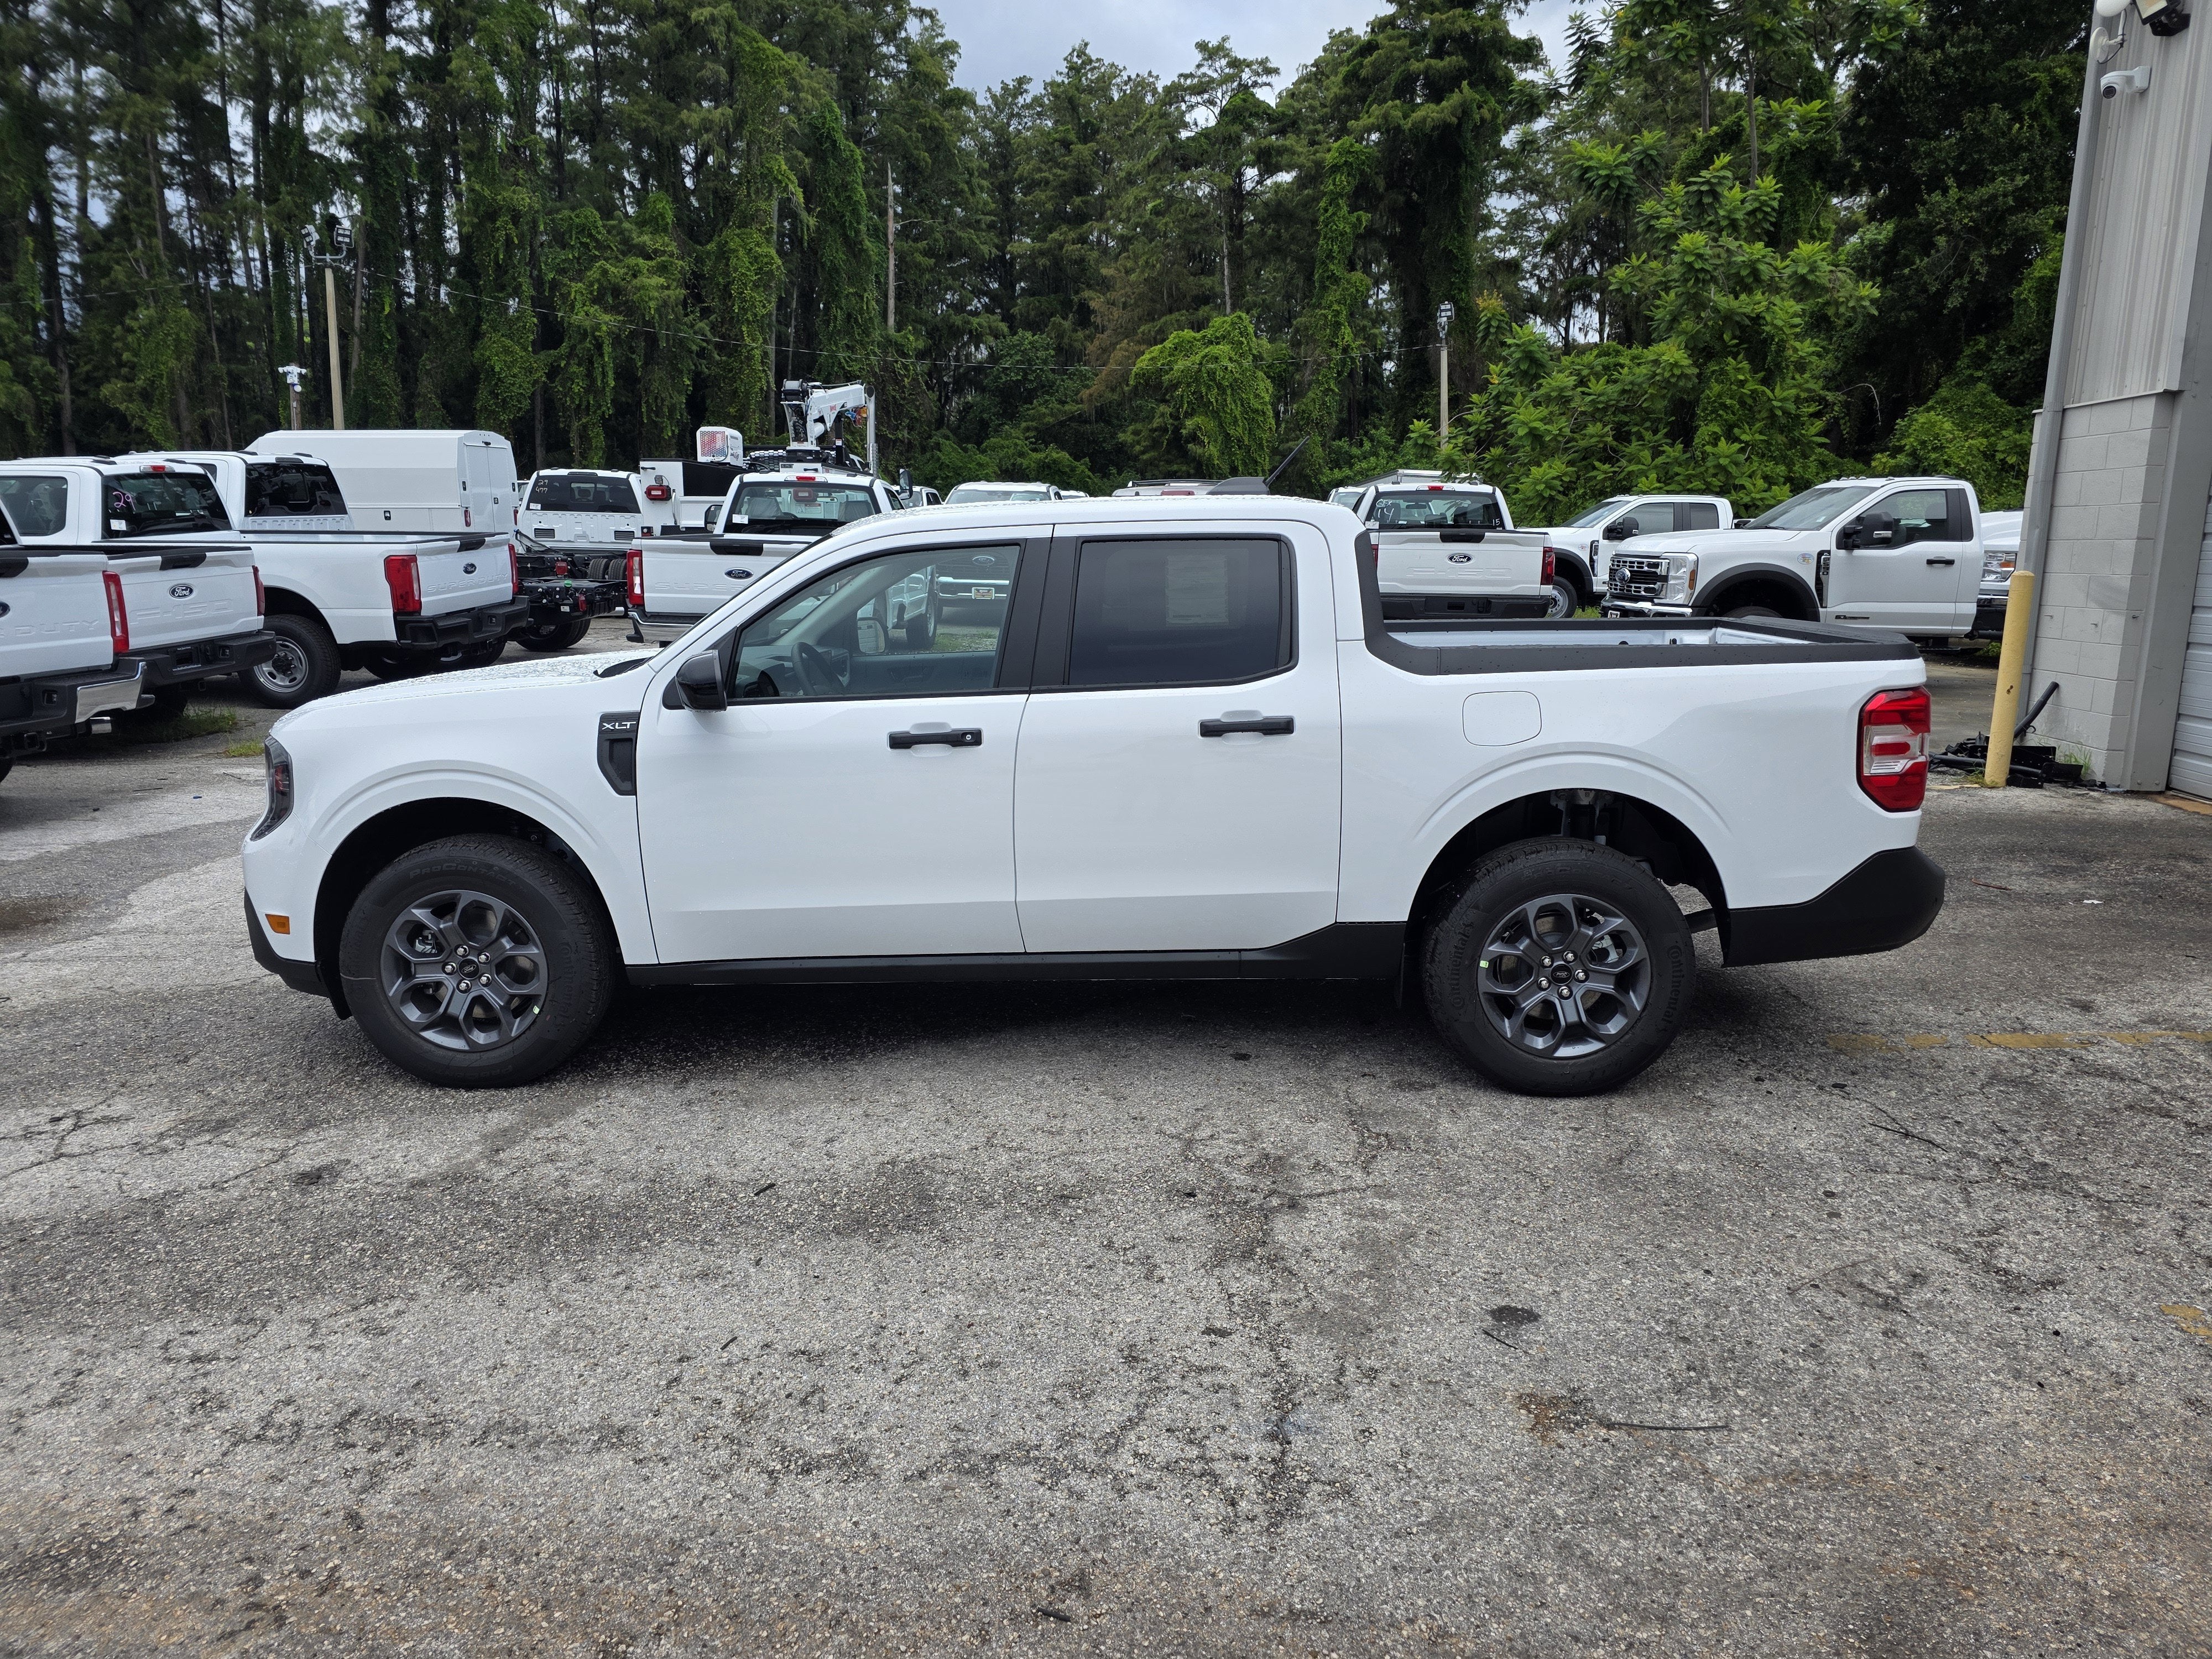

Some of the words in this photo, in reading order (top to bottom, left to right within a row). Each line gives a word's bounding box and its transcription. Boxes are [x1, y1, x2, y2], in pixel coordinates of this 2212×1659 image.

[112, 491, 136, 511] 29
[1376, 498, 1392, 508] GFX
[1378, 508, 1395, 523] 14
[1493, 518, 1500, 526] 15
[731, 570, 747, 578] Ford
[1406, 566, 1512, 578] F-150
[427, 578, 476, 593] SUPER
[478, 572, 508, 584] DUTY
[655, 582, 744, 592] SUPER
[174, 586, 190, 597] Ford
[129, 598, 234, 625] F-150
[14, 619, 99, 637] DUTY
[601, 721, 637, 730] XLT
[1448, 931, 1470, 1010] Continental
[1661, 945, 1684, 1024] Continental
